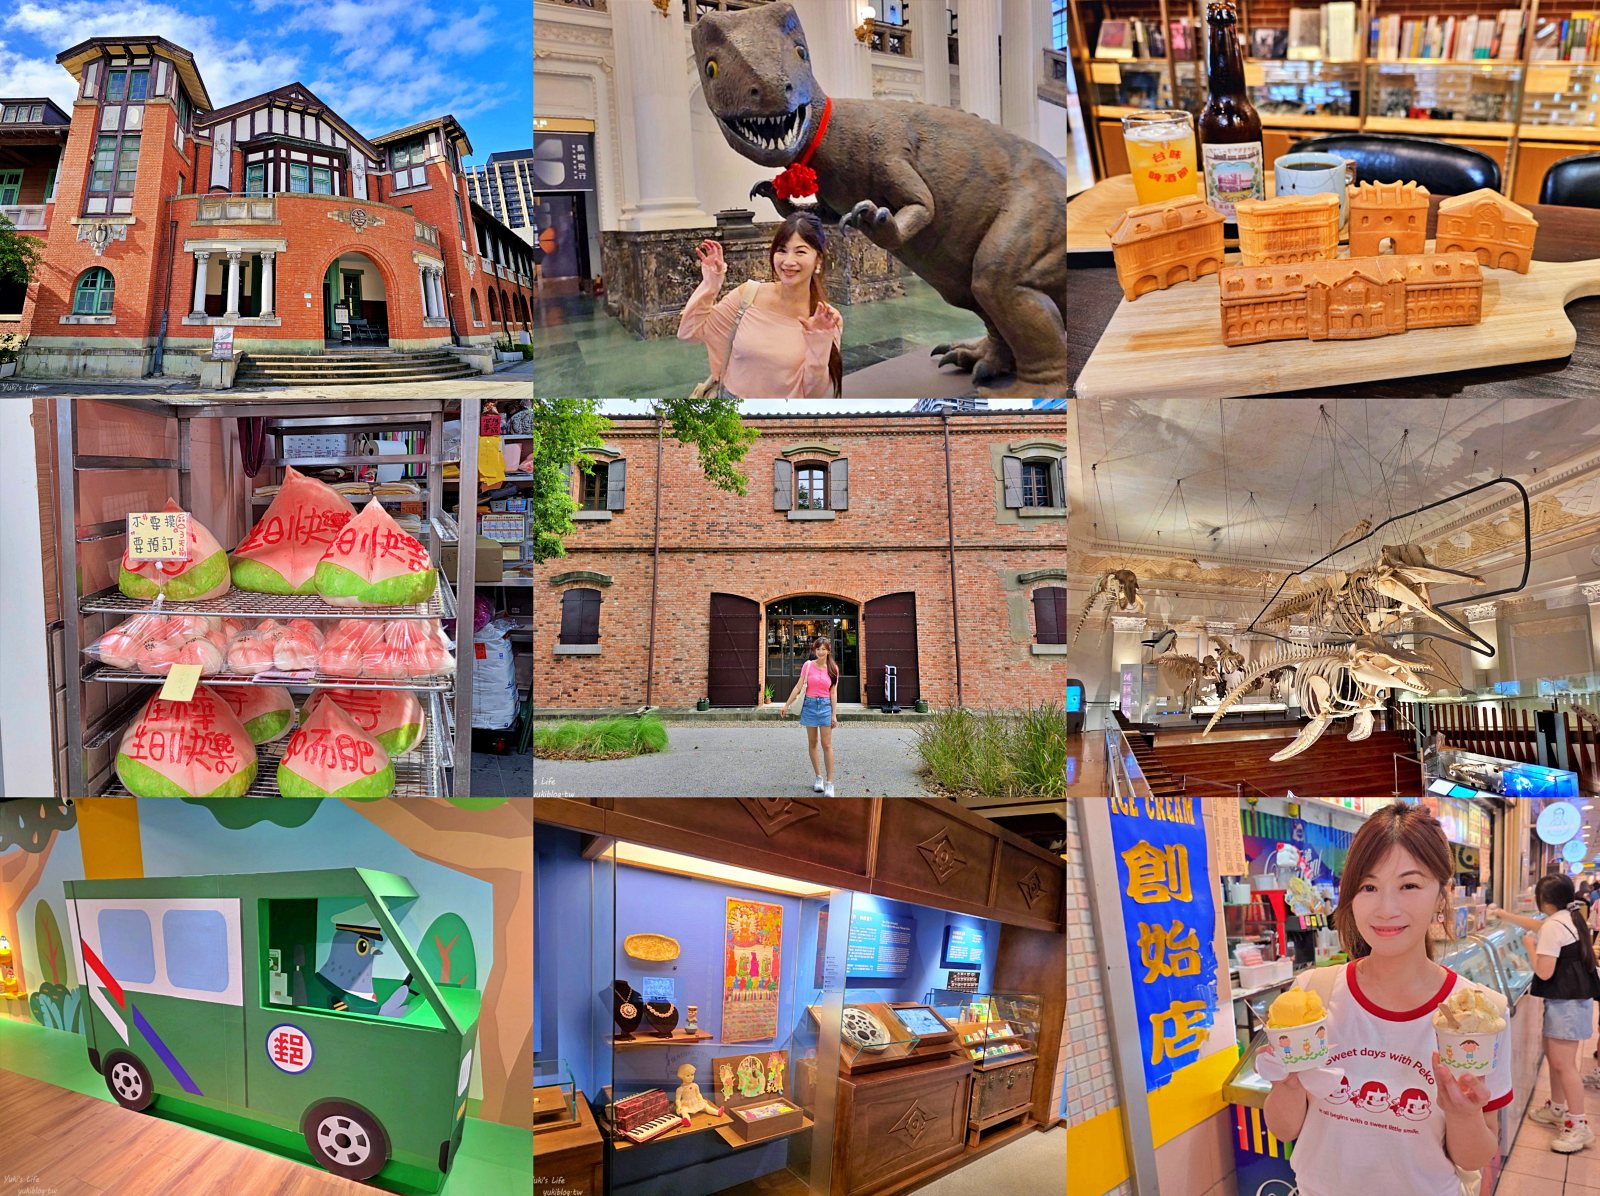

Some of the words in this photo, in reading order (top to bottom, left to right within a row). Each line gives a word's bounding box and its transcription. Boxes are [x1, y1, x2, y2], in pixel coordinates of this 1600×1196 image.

[1121, 839, 1210, 1066] 創始店
[1360, 1047, 1386, 1059] days
[1389, 1052, 1412, 1066] with
[1412, 1060, 1435, 1086] Peko
